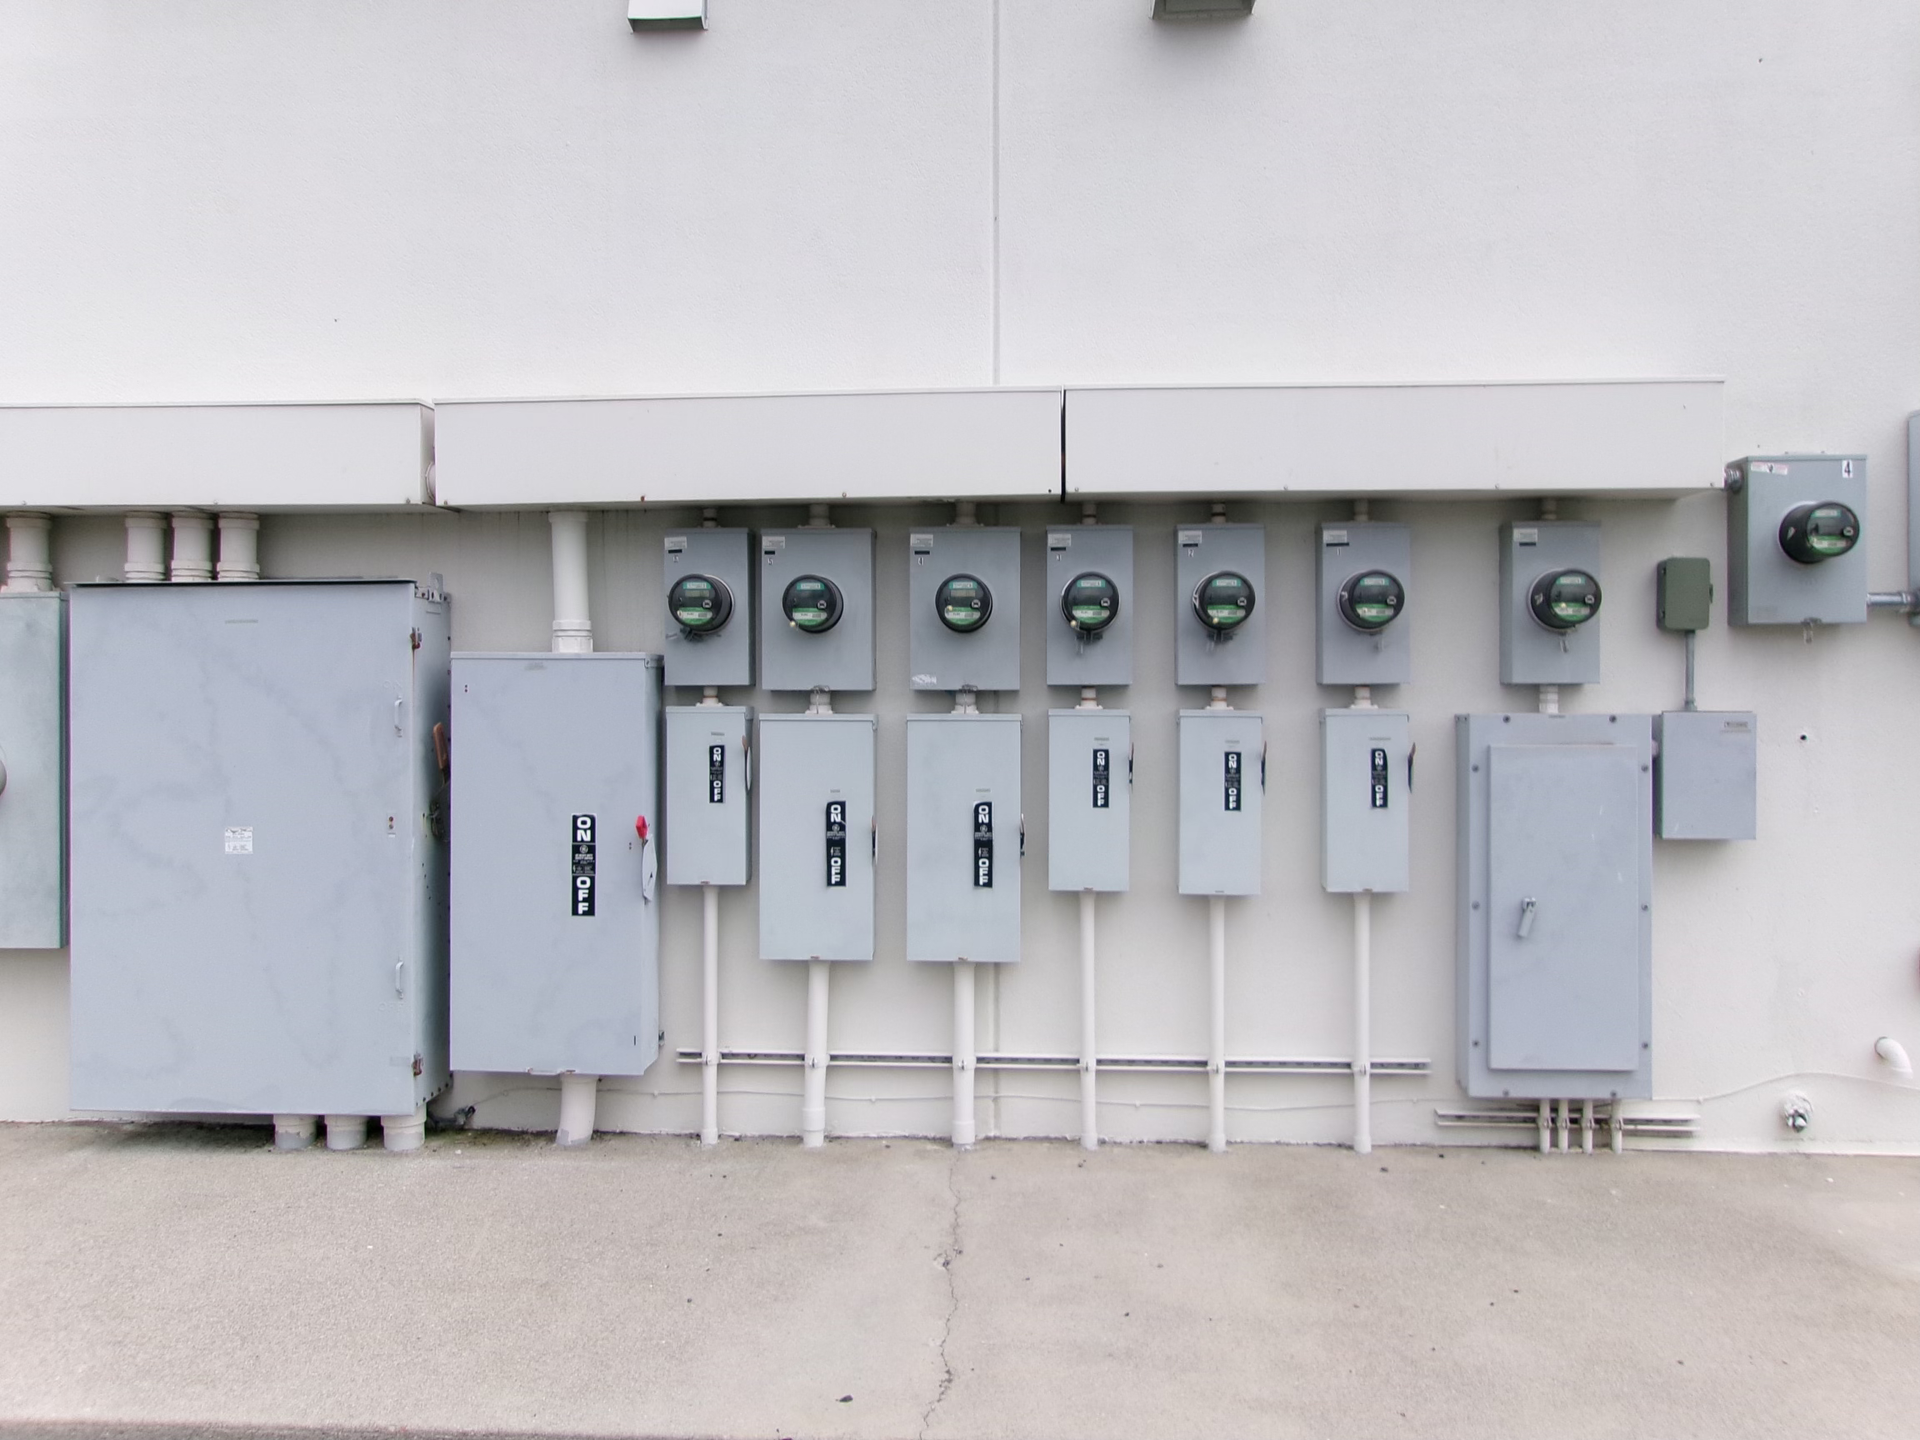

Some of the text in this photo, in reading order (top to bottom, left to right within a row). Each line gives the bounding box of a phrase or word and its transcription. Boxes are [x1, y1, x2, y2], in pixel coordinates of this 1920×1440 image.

[1844, 461, 1851, 477] 4
[713, 747, 721, 761] ON
[1097, 751, 1105, 765] ON
[1229, 754, 1237, 768] ON
[1375, 751, 1383, 765] ON
[713, 780, 721, 801] OFF
[1097, 785, 1105, 806] OFF
[1228, 788, 1236, 809] OFF
[1375, 785, 1383, 806] OFF
[831, 804, 841, 822] ON
[978, 805, 989, 823] ON
[577, 817, 591, 842] ON
[831, 857, 841, 884] OFF
[978, 858, 989, 885] OFF
[576, 876, 591, 915] OFF
